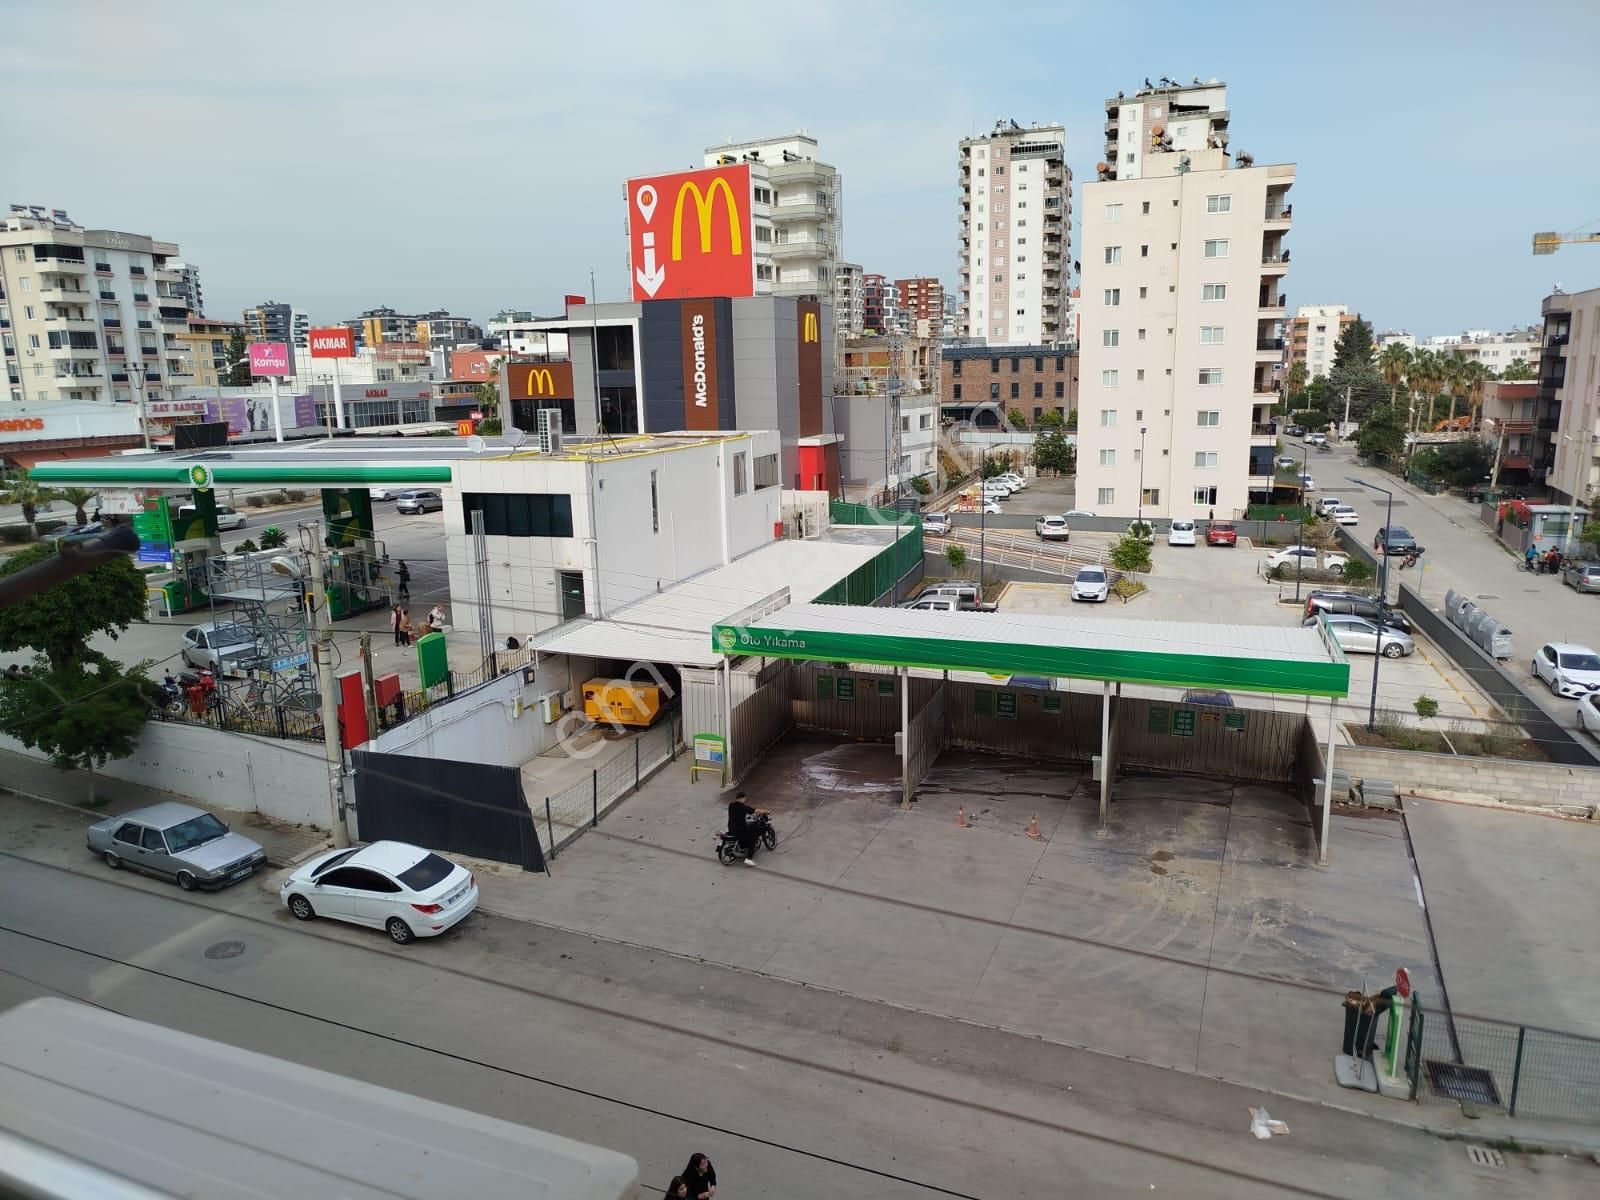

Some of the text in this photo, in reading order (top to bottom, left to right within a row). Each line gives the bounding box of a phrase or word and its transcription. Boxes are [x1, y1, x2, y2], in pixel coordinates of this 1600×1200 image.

[313, 337, 347, 350] AKMAR
[254, 357, 285, 368] Komşu
[692, 314, 707, 408] McDonald's
[741, 634, 760, 646] Oto
